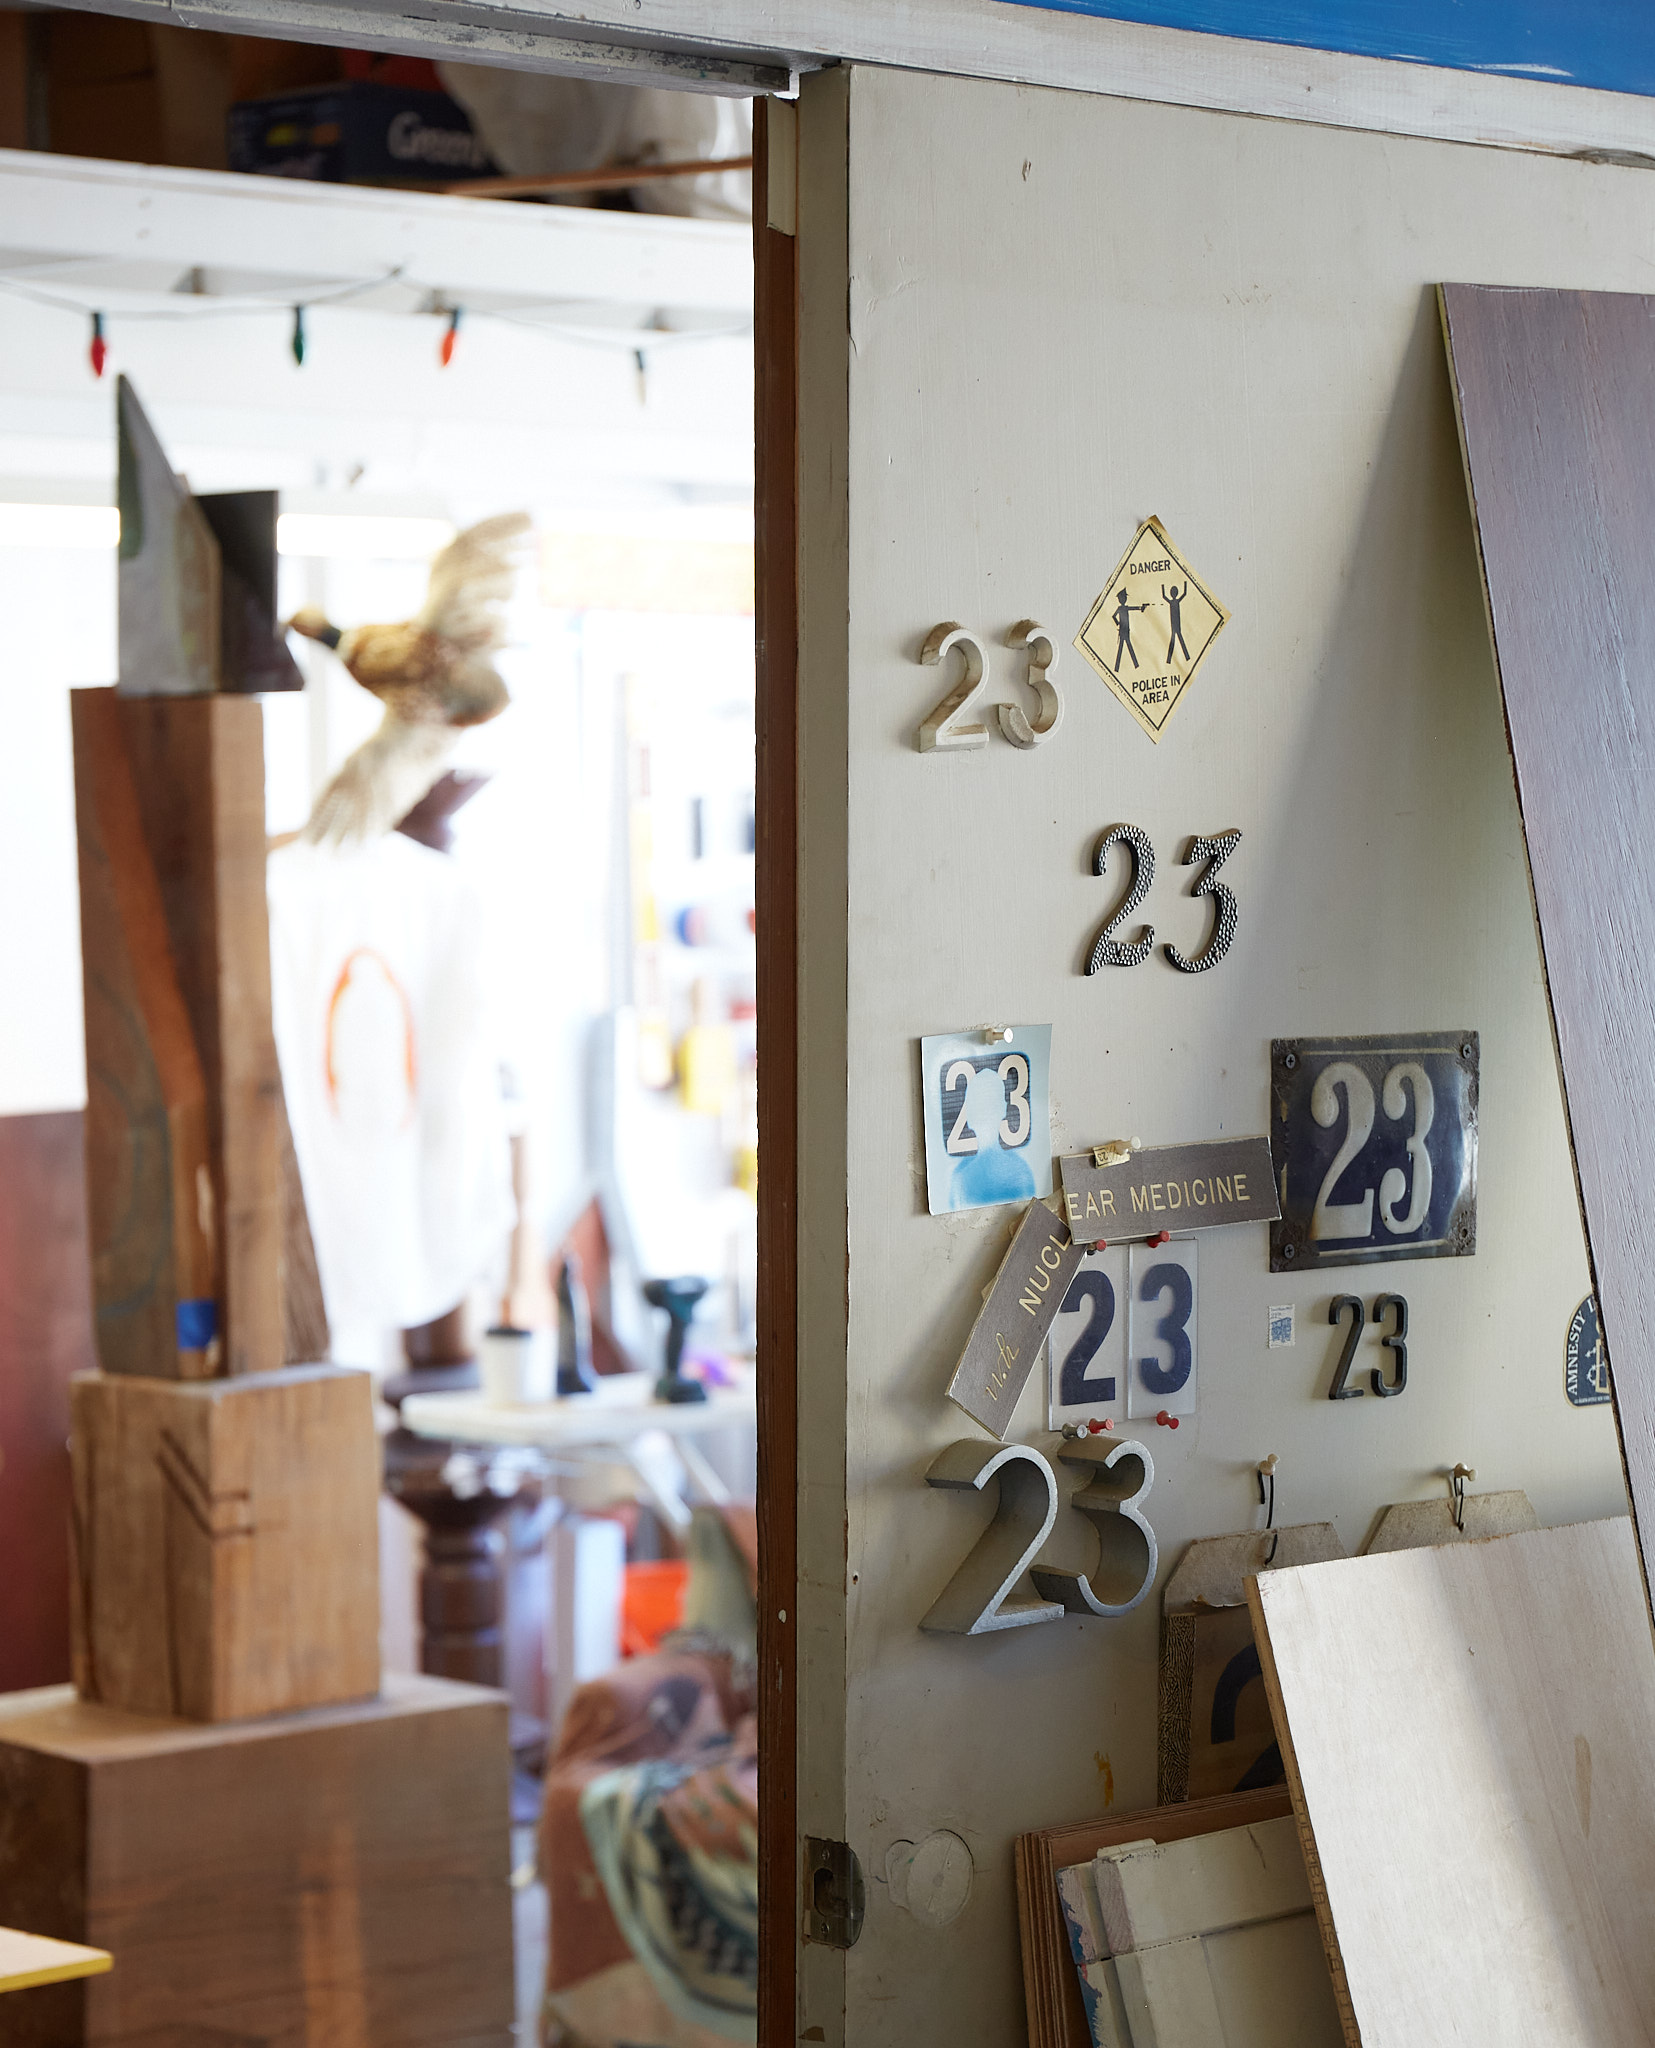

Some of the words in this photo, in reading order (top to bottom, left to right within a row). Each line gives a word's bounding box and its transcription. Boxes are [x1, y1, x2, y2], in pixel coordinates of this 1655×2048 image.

[1129, 559, 1171, 576] DANGER
[919, 619, 1065, 753] 23
[1131, 676, 1168, 693] POLICE
[1170, 674, 1181, 687] IN
[1142, 689, 1170, 705] AREA
[1084, 822, 1243, 977] 23
[945, 1053, 1031, 1154] 23
[1309, 1060, 1435, 1241] 23
[1066, 1189, 1117, 1221] EAR
[1129, 1173, 1251, 1214] MEDICINE
[1018, 1233, 1072, 1316] NUCL
[1059, 1262, 1193, 1407] 23
[1328, 1292, 1409, 1400] 23
[1567, 1310, 1586, 1396] AMNESTY
[918, 1437, 1158, 1635] 23
